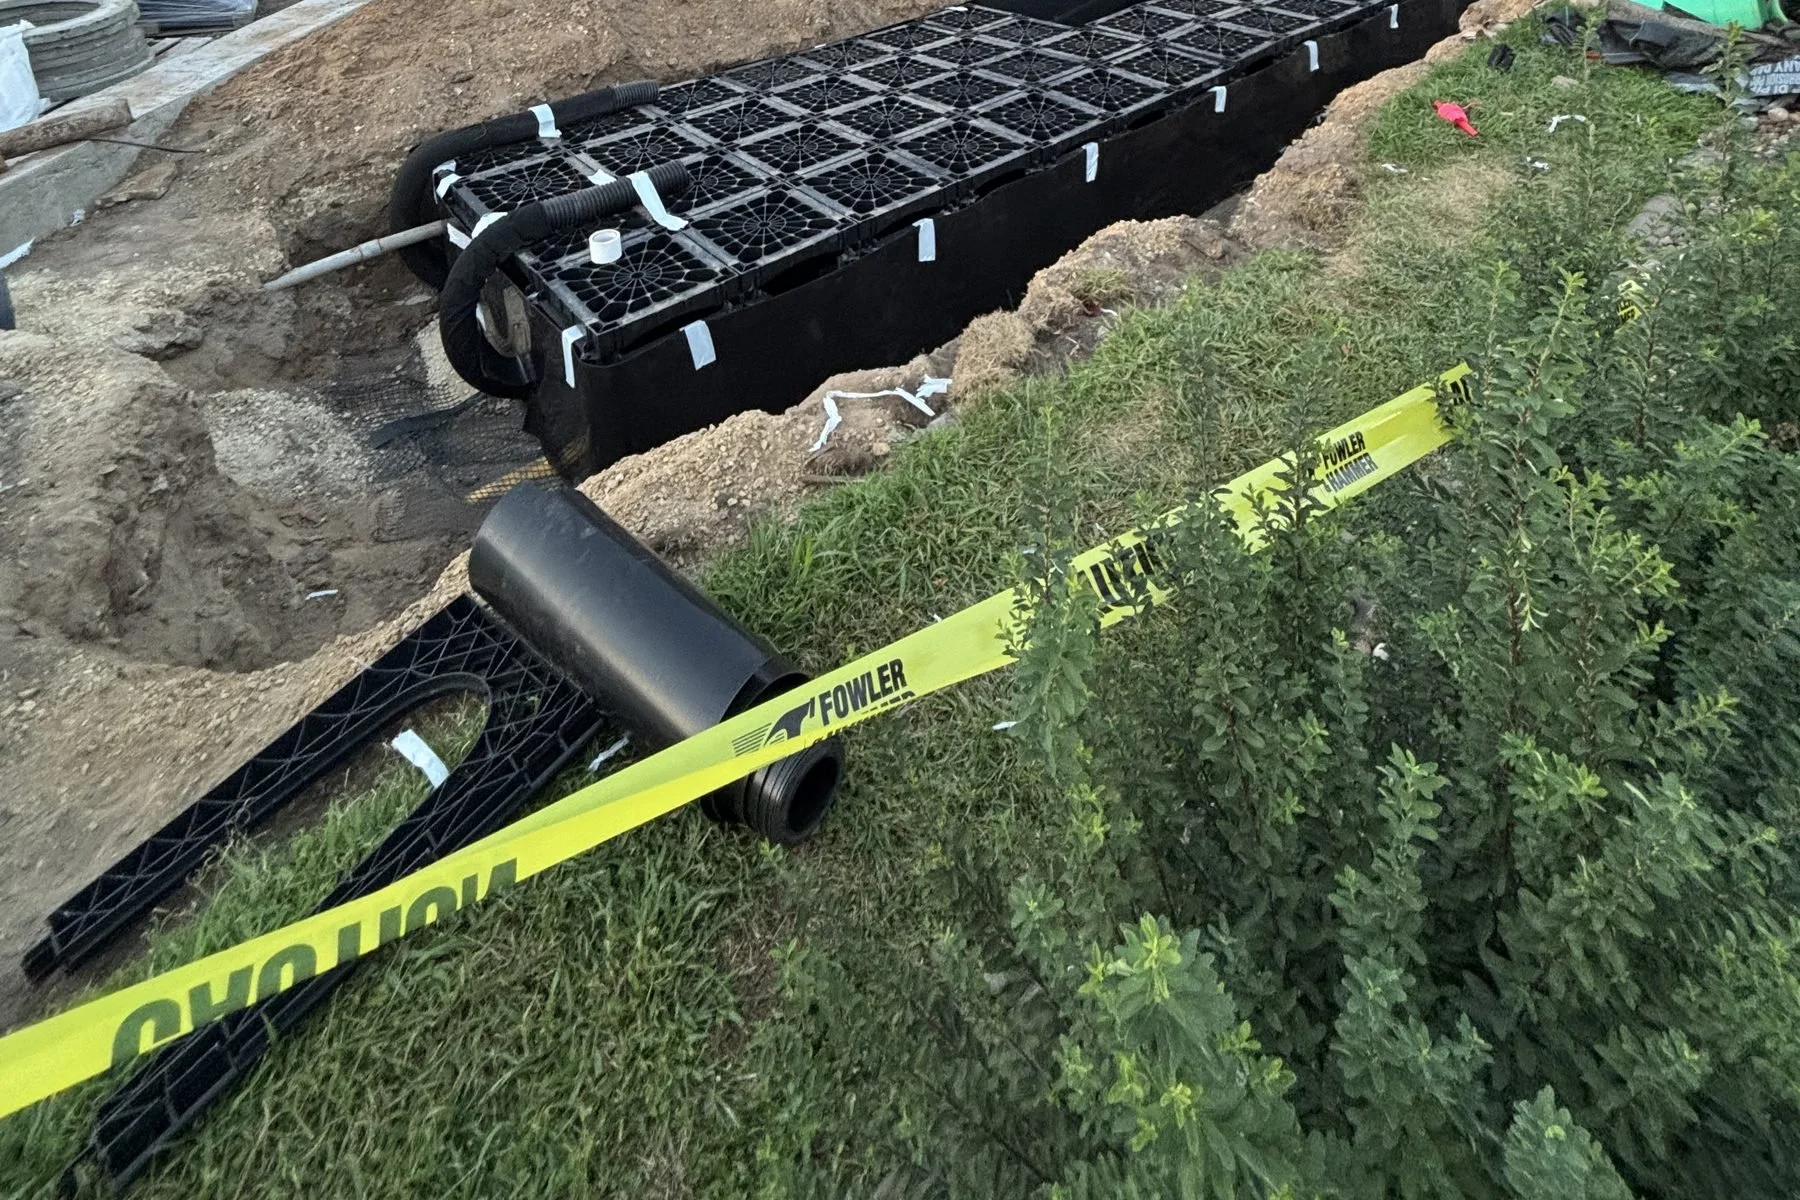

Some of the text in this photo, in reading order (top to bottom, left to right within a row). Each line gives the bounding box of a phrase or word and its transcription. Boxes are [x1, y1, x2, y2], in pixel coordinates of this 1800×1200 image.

[1323, 430, 1366, 470] FOWLER
[1326, 452, 1379, 492] HAMMER
[818, 658, 908, 727] FOWLER
